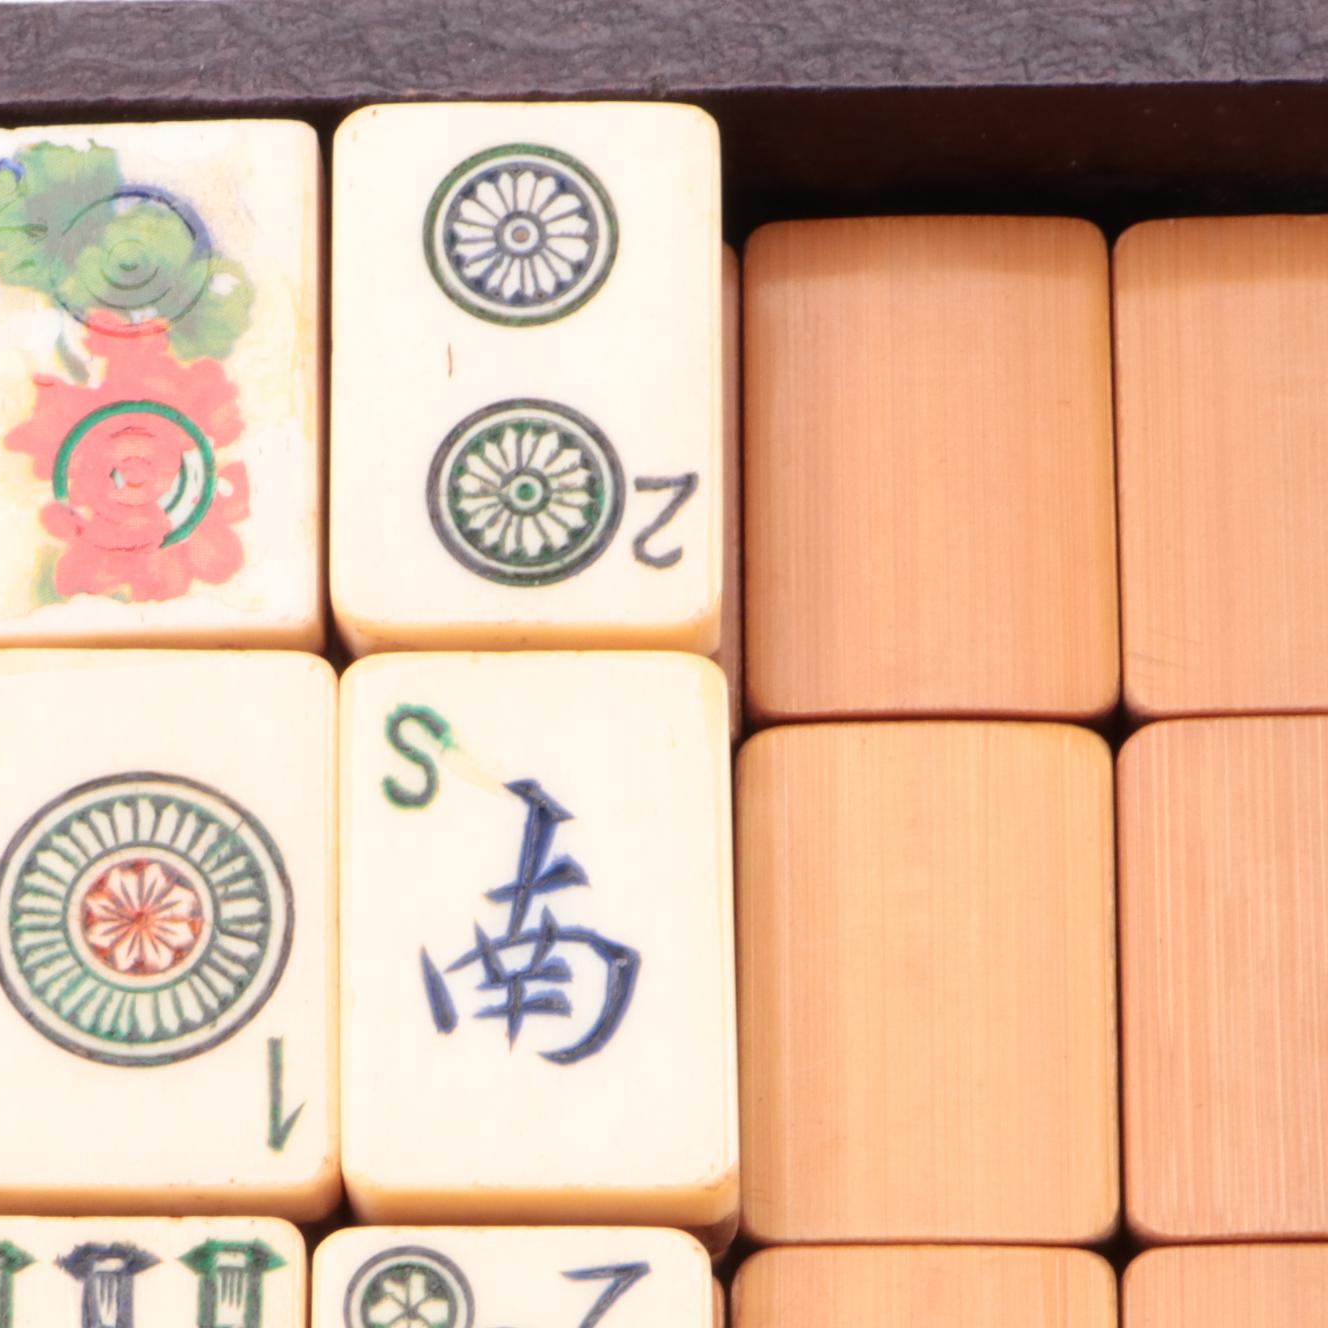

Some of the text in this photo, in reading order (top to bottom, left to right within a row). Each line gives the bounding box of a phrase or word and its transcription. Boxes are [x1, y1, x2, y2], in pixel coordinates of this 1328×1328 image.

[633, 472, 699, 570] 2
[383, 703, 456, 809] S
[419, 777, 642, 1067] 南
[267, 1036, 305, 1152] 1
